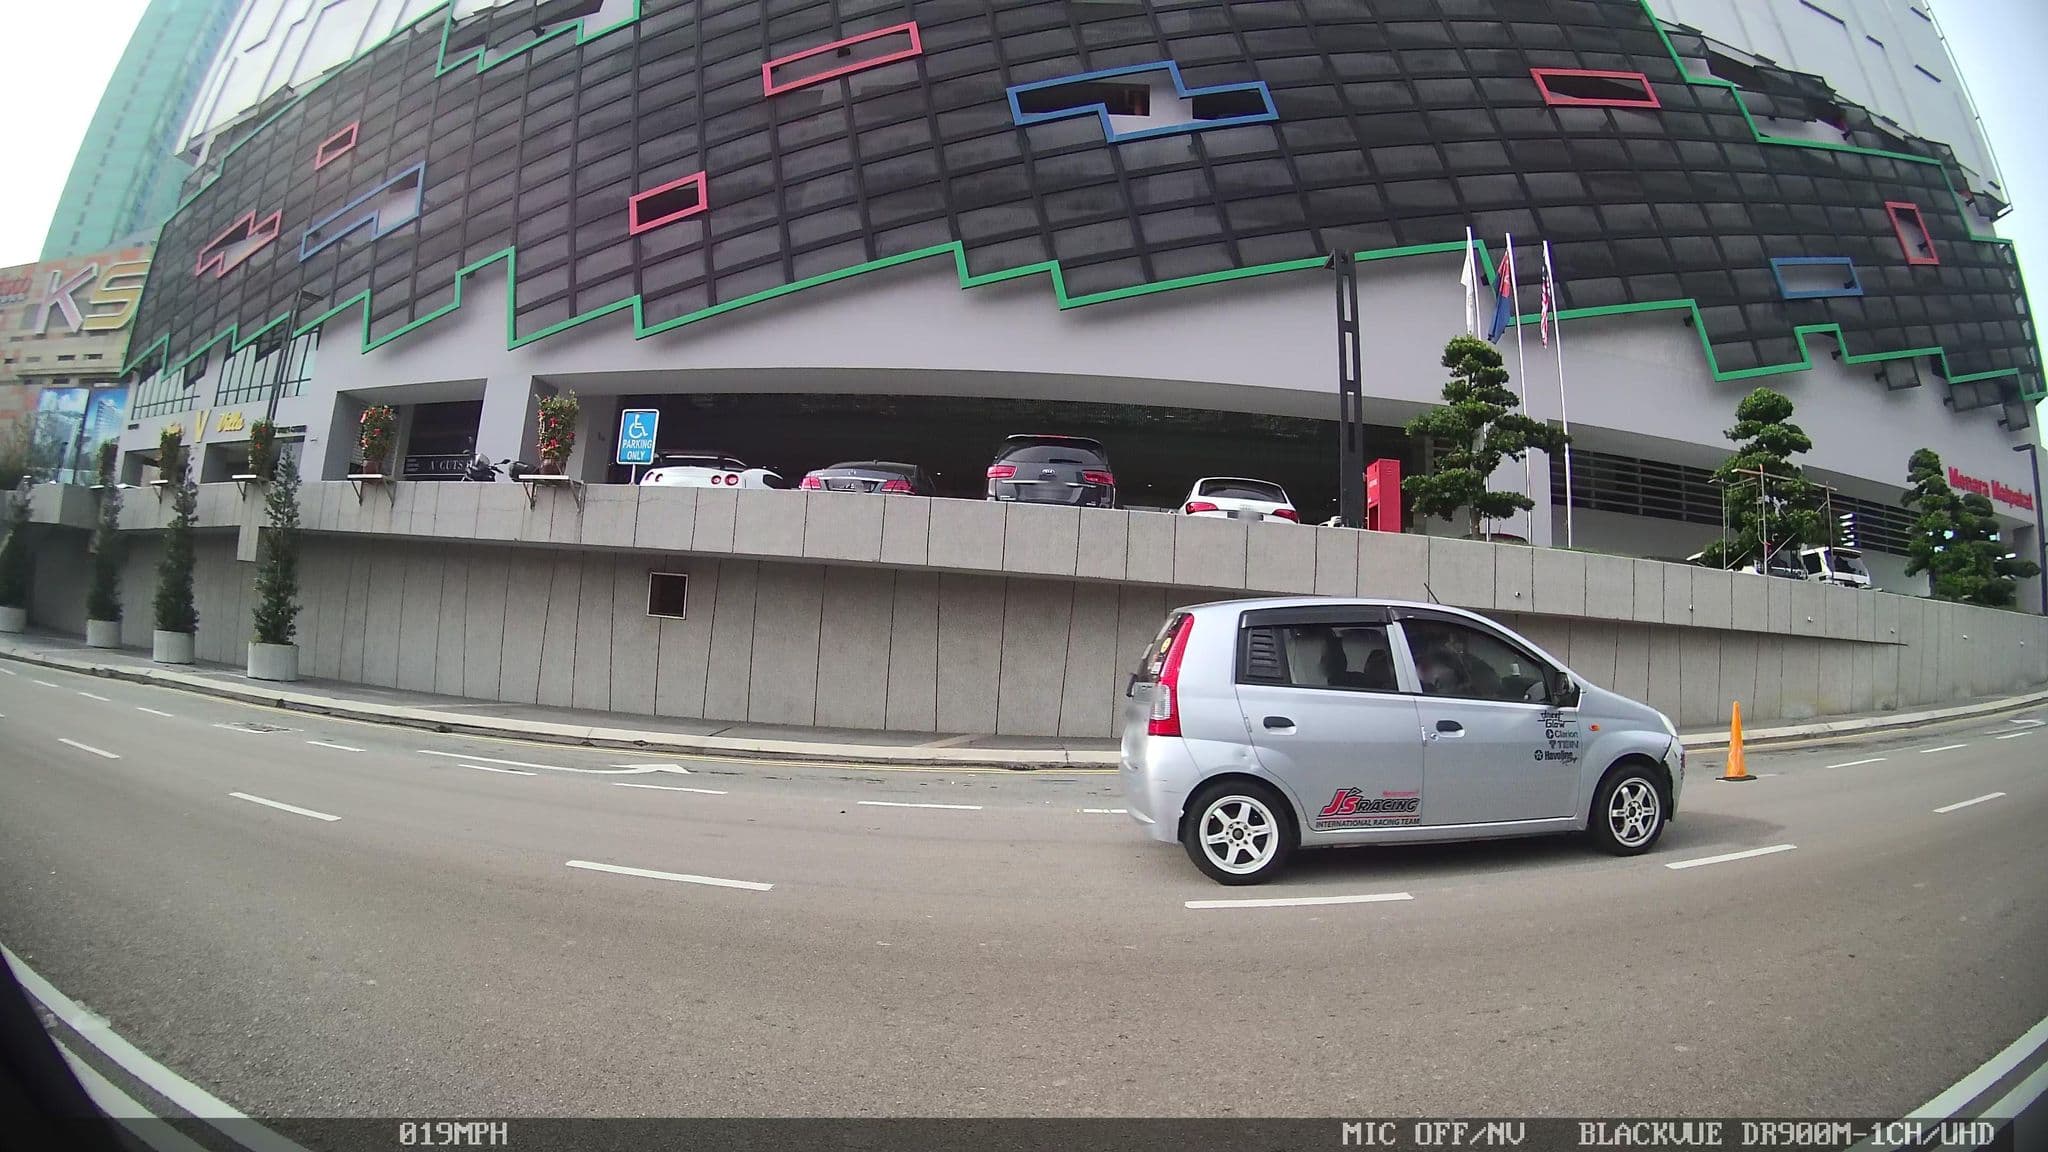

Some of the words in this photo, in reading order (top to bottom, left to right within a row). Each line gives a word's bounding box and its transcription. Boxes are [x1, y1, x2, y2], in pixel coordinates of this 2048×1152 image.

[622, 440, 653, 449] PARKING
[626, 450, 646, 460] ONLY
[1357, 799, 1420, 814] RACING
[1316, 820, 1372, 829] INTERNATIONAL
[1373, 819, 1400, 828] RACING
[1400, 818, 1420, 826] TEAM
